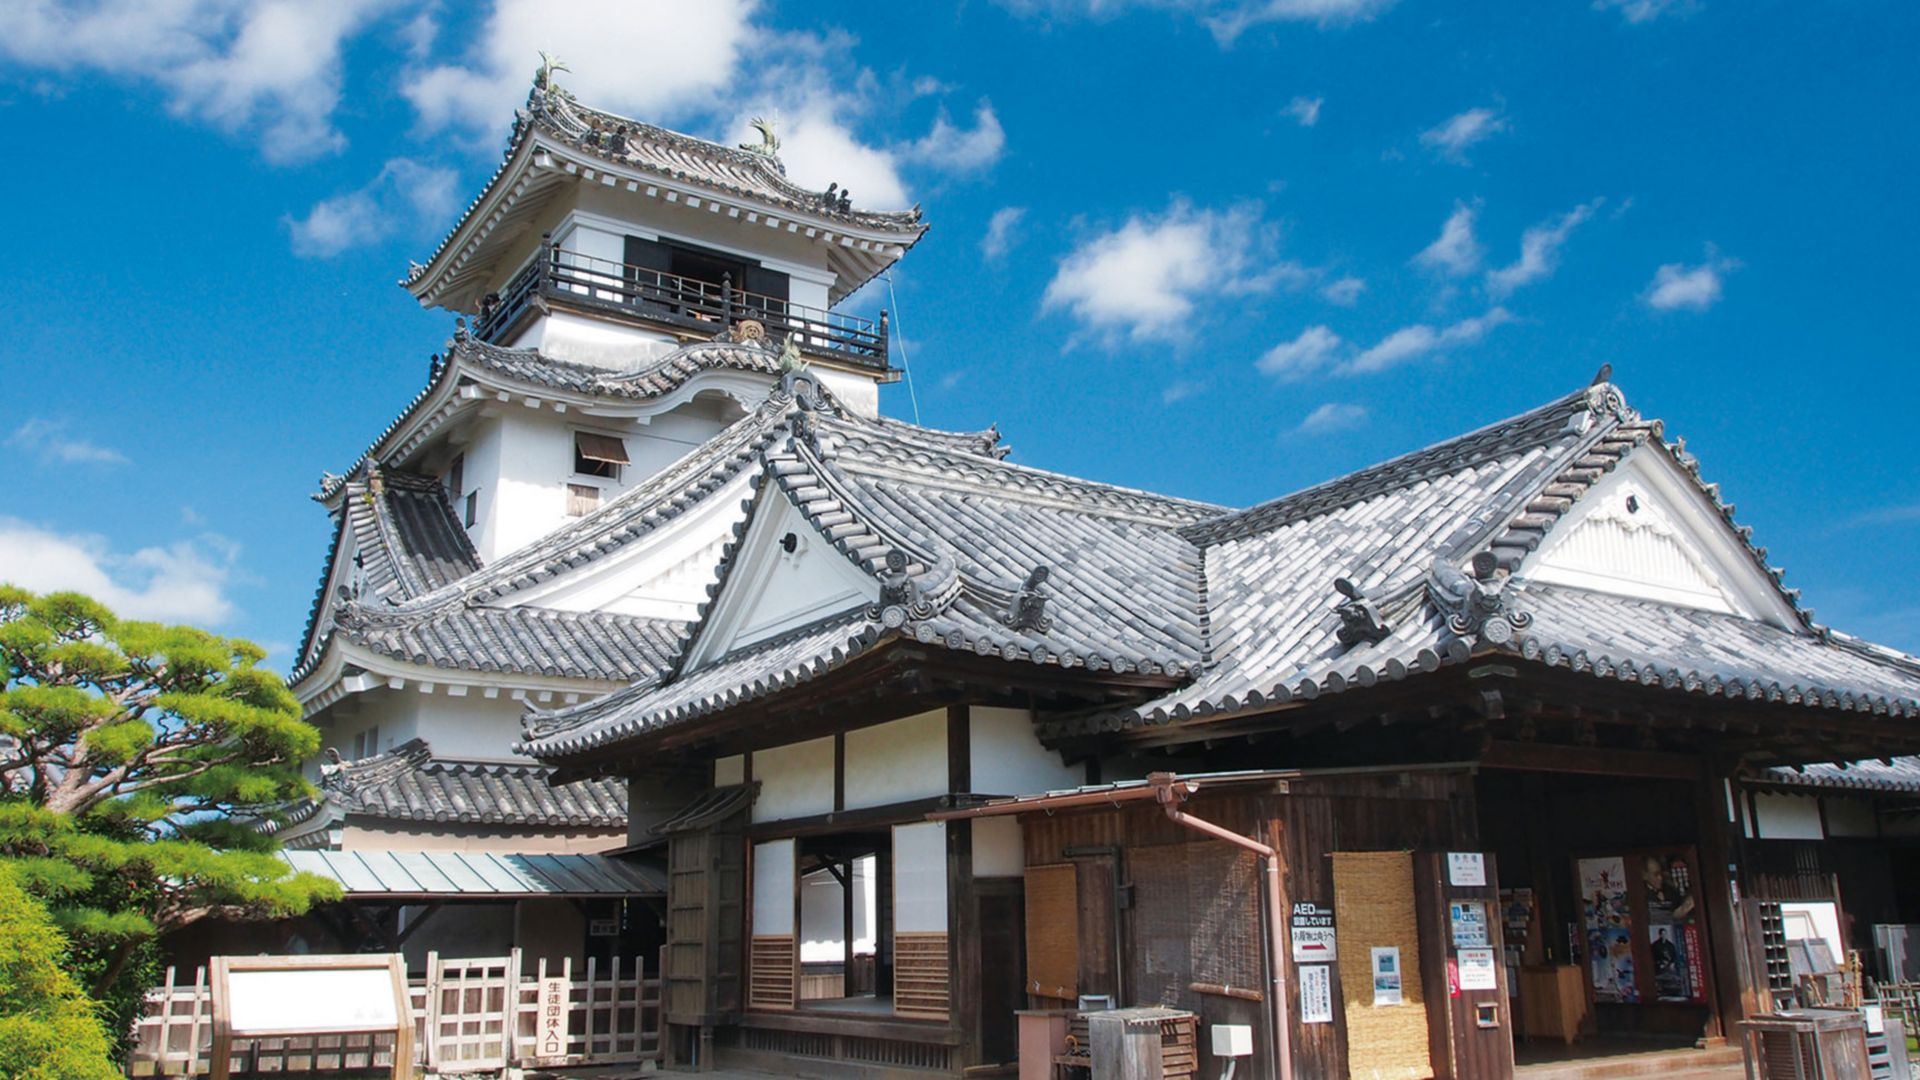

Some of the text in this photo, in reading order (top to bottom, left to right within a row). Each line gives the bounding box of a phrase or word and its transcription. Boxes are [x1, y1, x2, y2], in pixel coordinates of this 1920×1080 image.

[1293, 903, 1316, 915] AED
[545, 982, 561, 1053] 生徒団体入口
